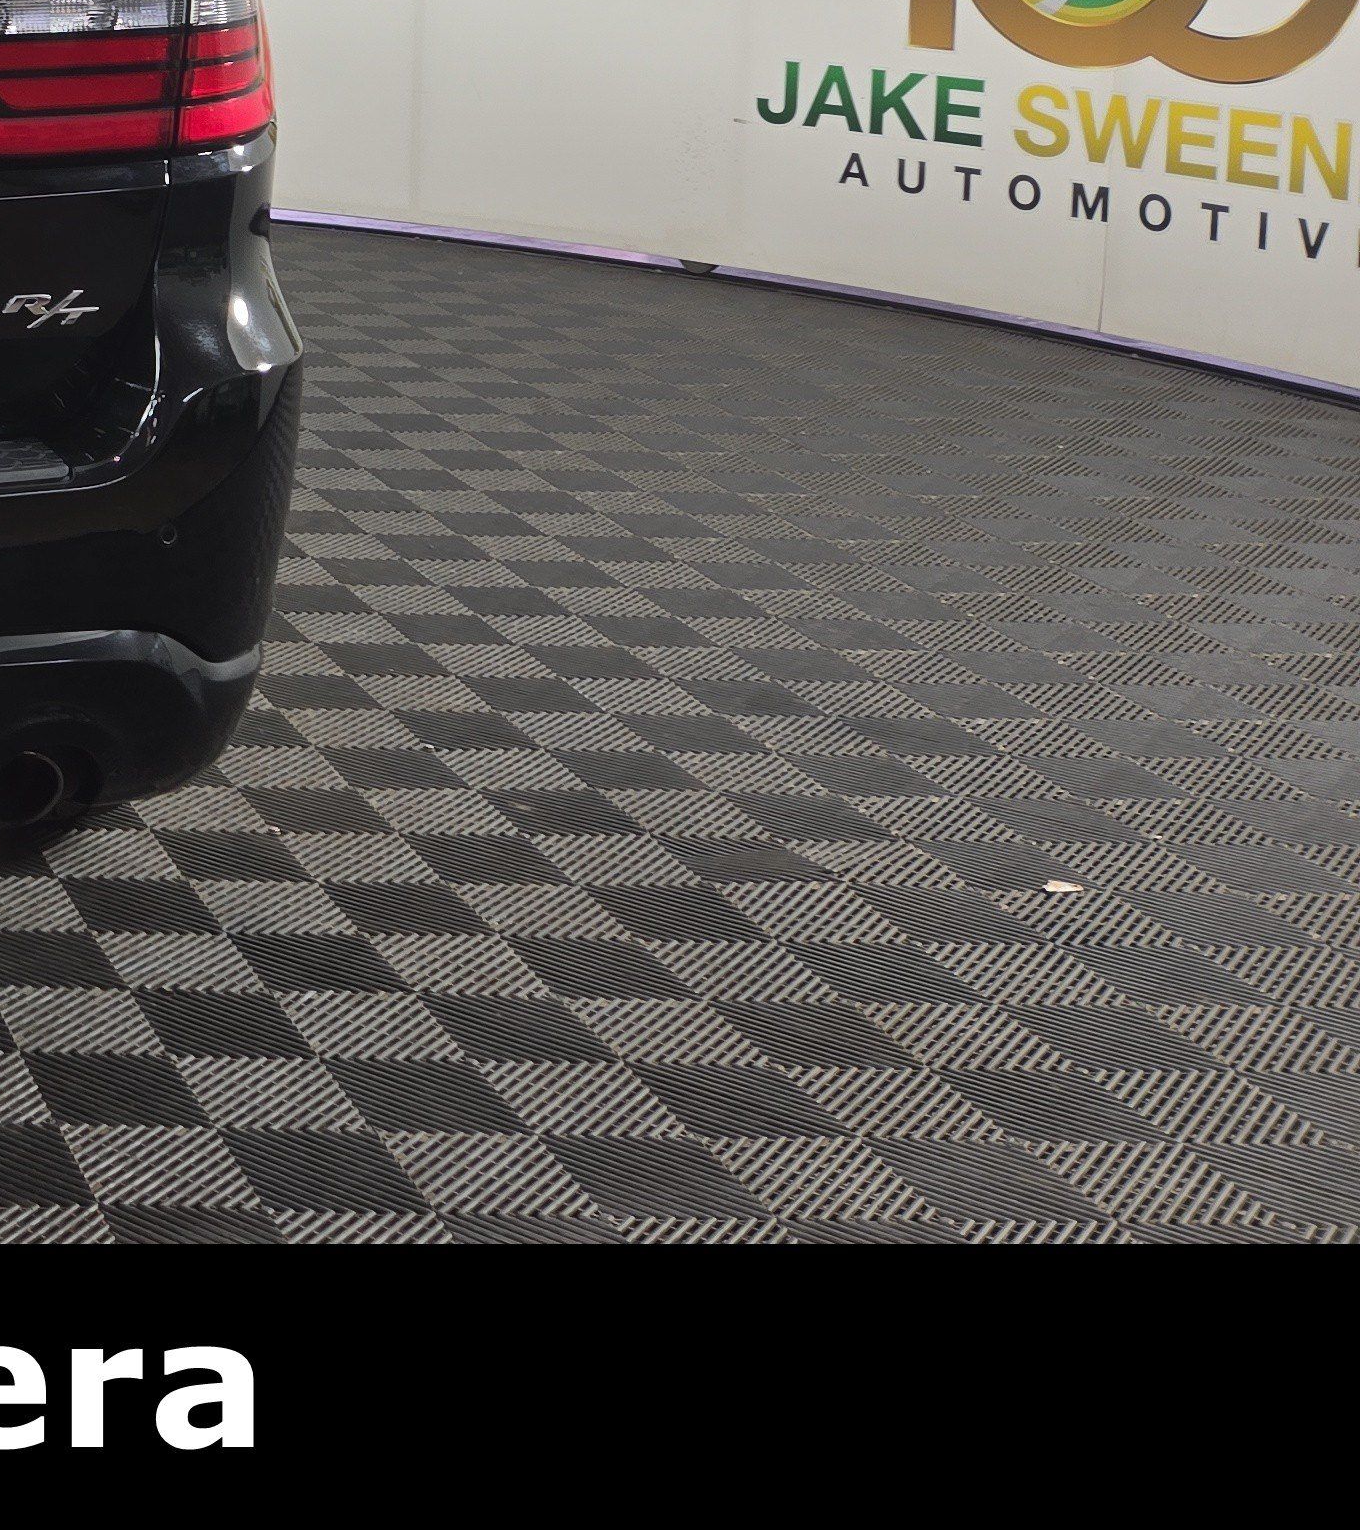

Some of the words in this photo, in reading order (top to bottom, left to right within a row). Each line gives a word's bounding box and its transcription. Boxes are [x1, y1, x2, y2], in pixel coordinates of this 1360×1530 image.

[756, 61, 985, 148] JAKE
[1013, 84, 1360, 201] SWEEN
[839, 152, 1360, 268] AUTOMOTIV
[1, 290, 99, 329] R/T
